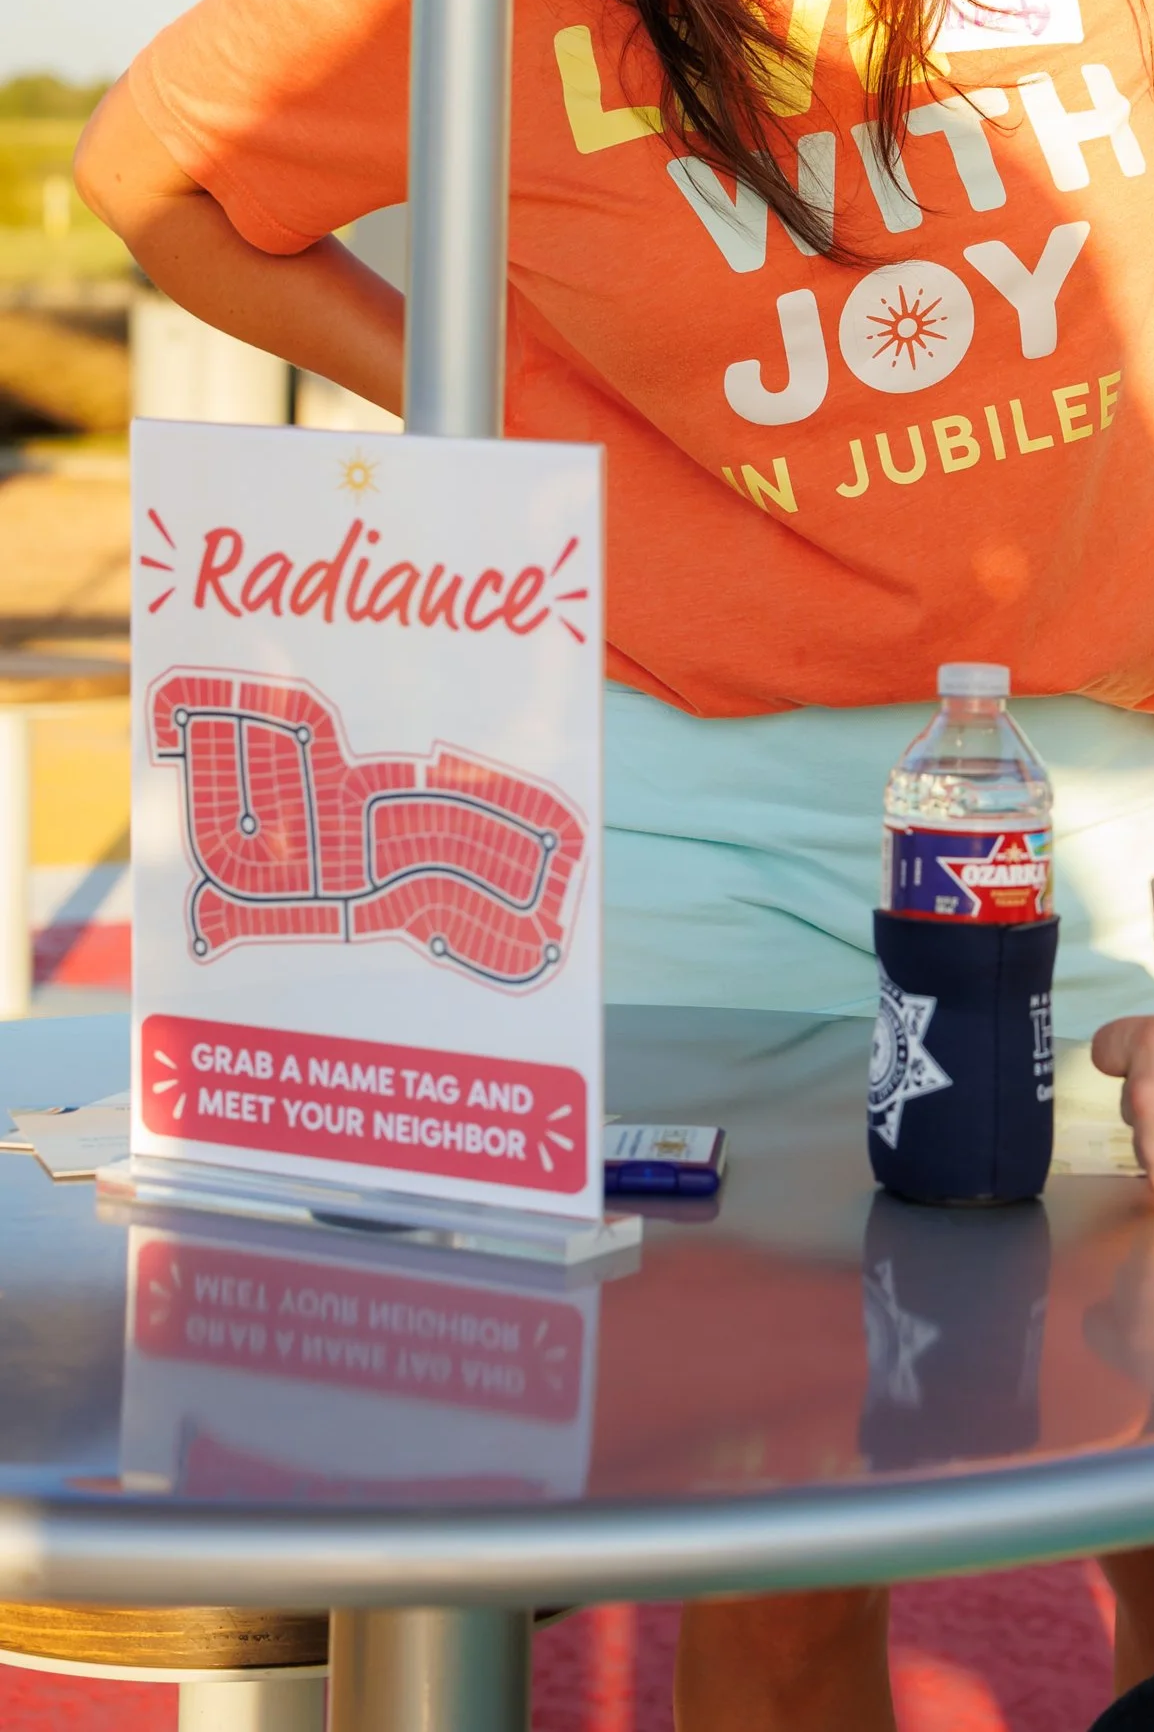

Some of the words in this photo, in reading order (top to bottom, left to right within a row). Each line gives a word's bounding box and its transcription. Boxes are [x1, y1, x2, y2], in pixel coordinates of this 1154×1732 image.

[666, 63, 1146, 274] WITH
[723, 221, 1090, 426] JOY
[835, 370, 1121, 498] JUBILEE
[194, 518, 552, 635] Radiance
[191, 1043, 274, 1079] GRAB
[279, 1054, 303, 1084] A
[308, 1057, 396, 1097] NAME
[401, 1069, 461, 1105] TAG
[467, 1079, 535, 1115] AND
[198, 1087, 276, 1124] MEET
[282, 1098, 365, 1138] YOUR
[373, 1110, 528, 1161] NEIGHBOR
